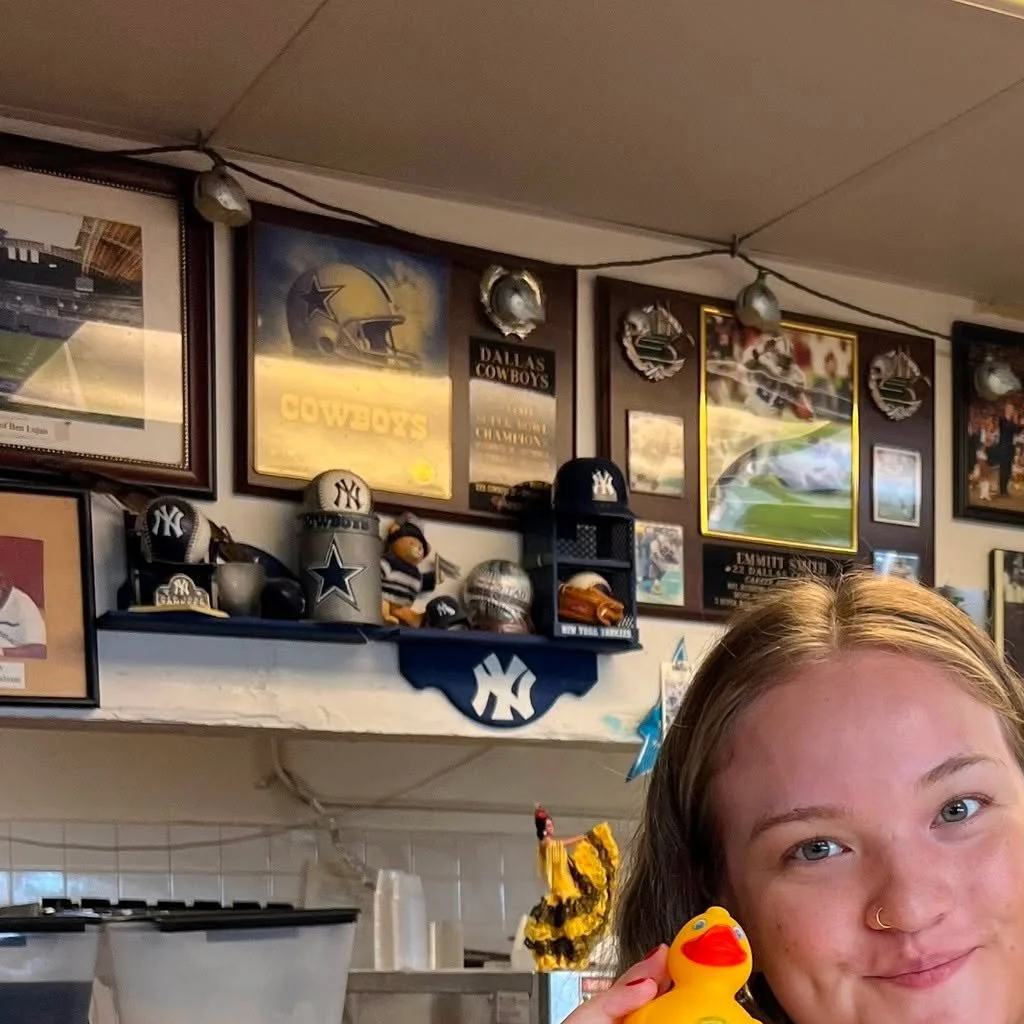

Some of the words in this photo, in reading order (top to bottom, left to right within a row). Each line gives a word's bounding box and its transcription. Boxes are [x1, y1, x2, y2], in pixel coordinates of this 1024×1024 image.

[479, 346, 545, 372] DALLAS
[475, 362, 550, 389] COWBOYS
[280, 393, 428, 440] COWBOYS
[151, 504, 185, 539] NY
